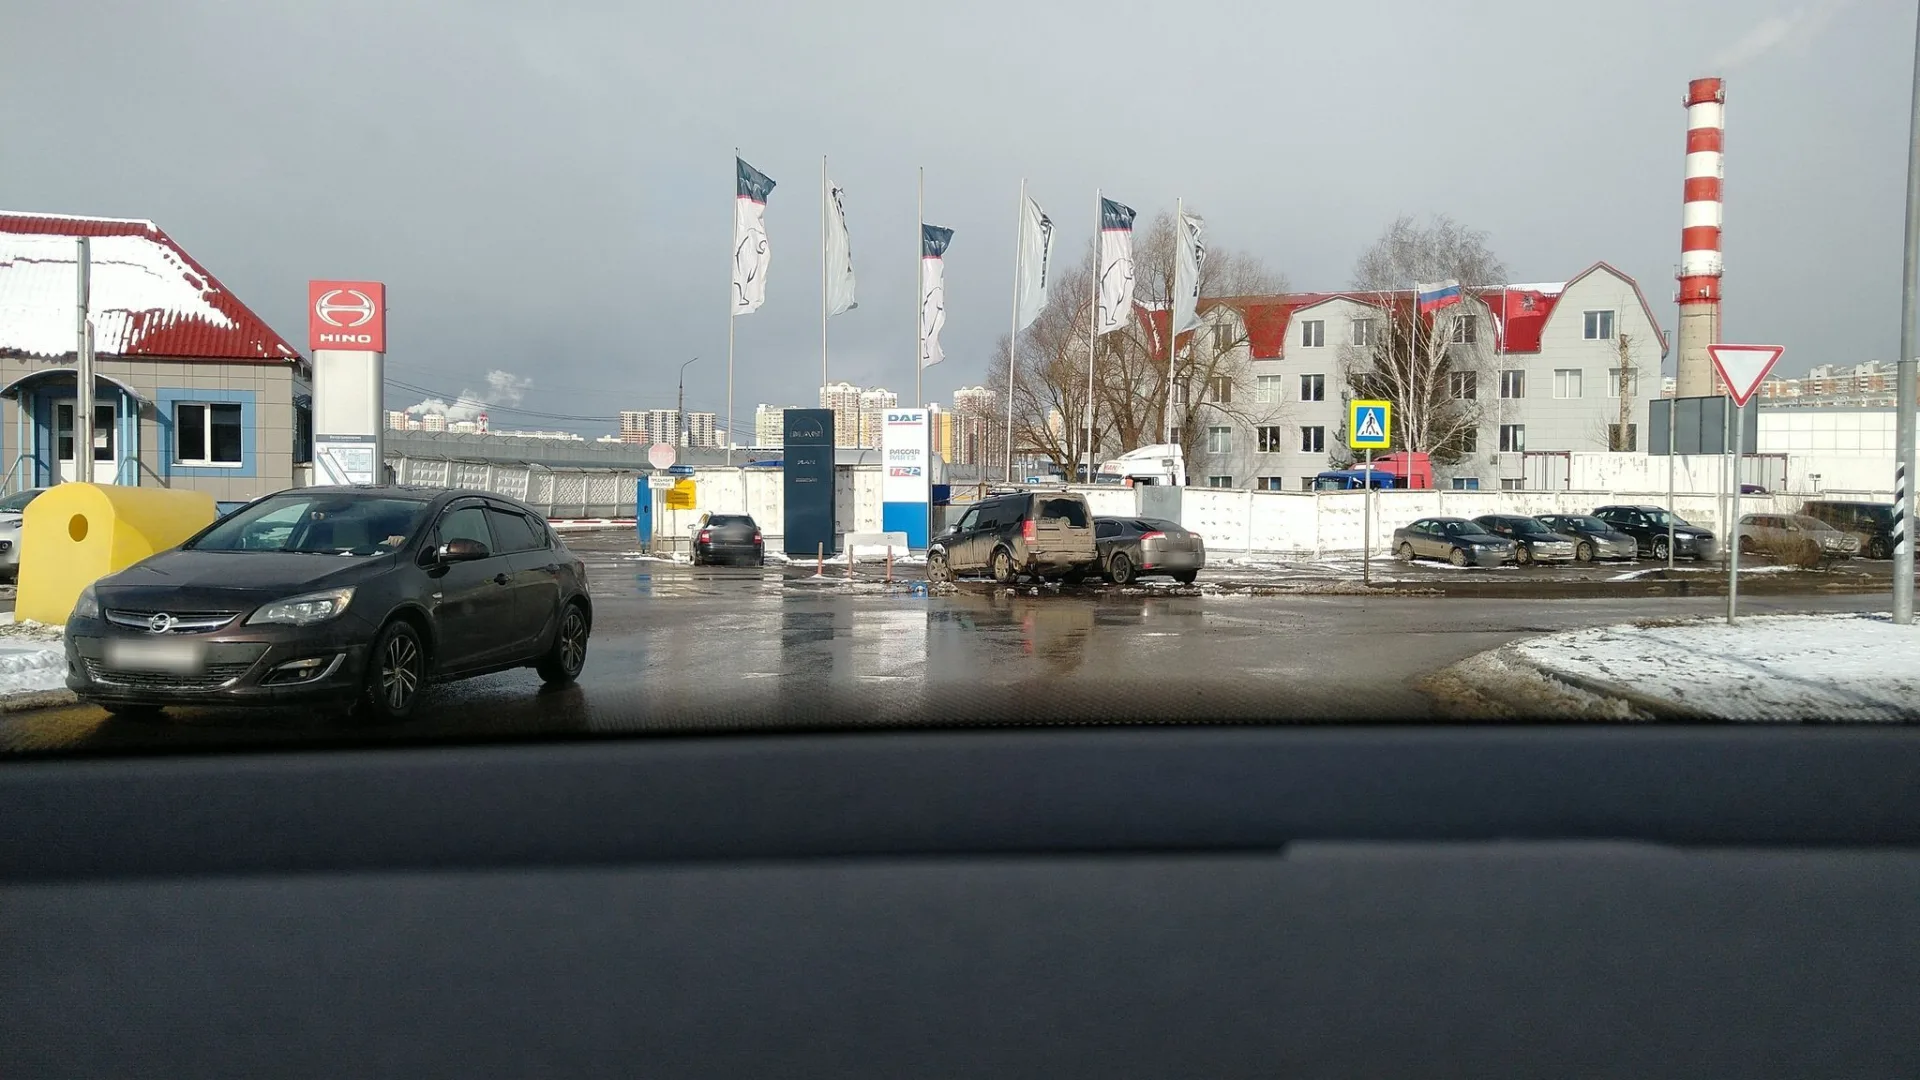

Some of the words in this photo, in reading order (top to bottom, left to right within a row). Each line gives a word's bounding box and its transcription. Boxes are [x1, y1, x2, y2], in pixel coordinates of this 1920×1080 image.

[320, 333, 372, 344] HINO
[792, 430, 821, 438] MAN
[890, 467, 921, 477] TRP
